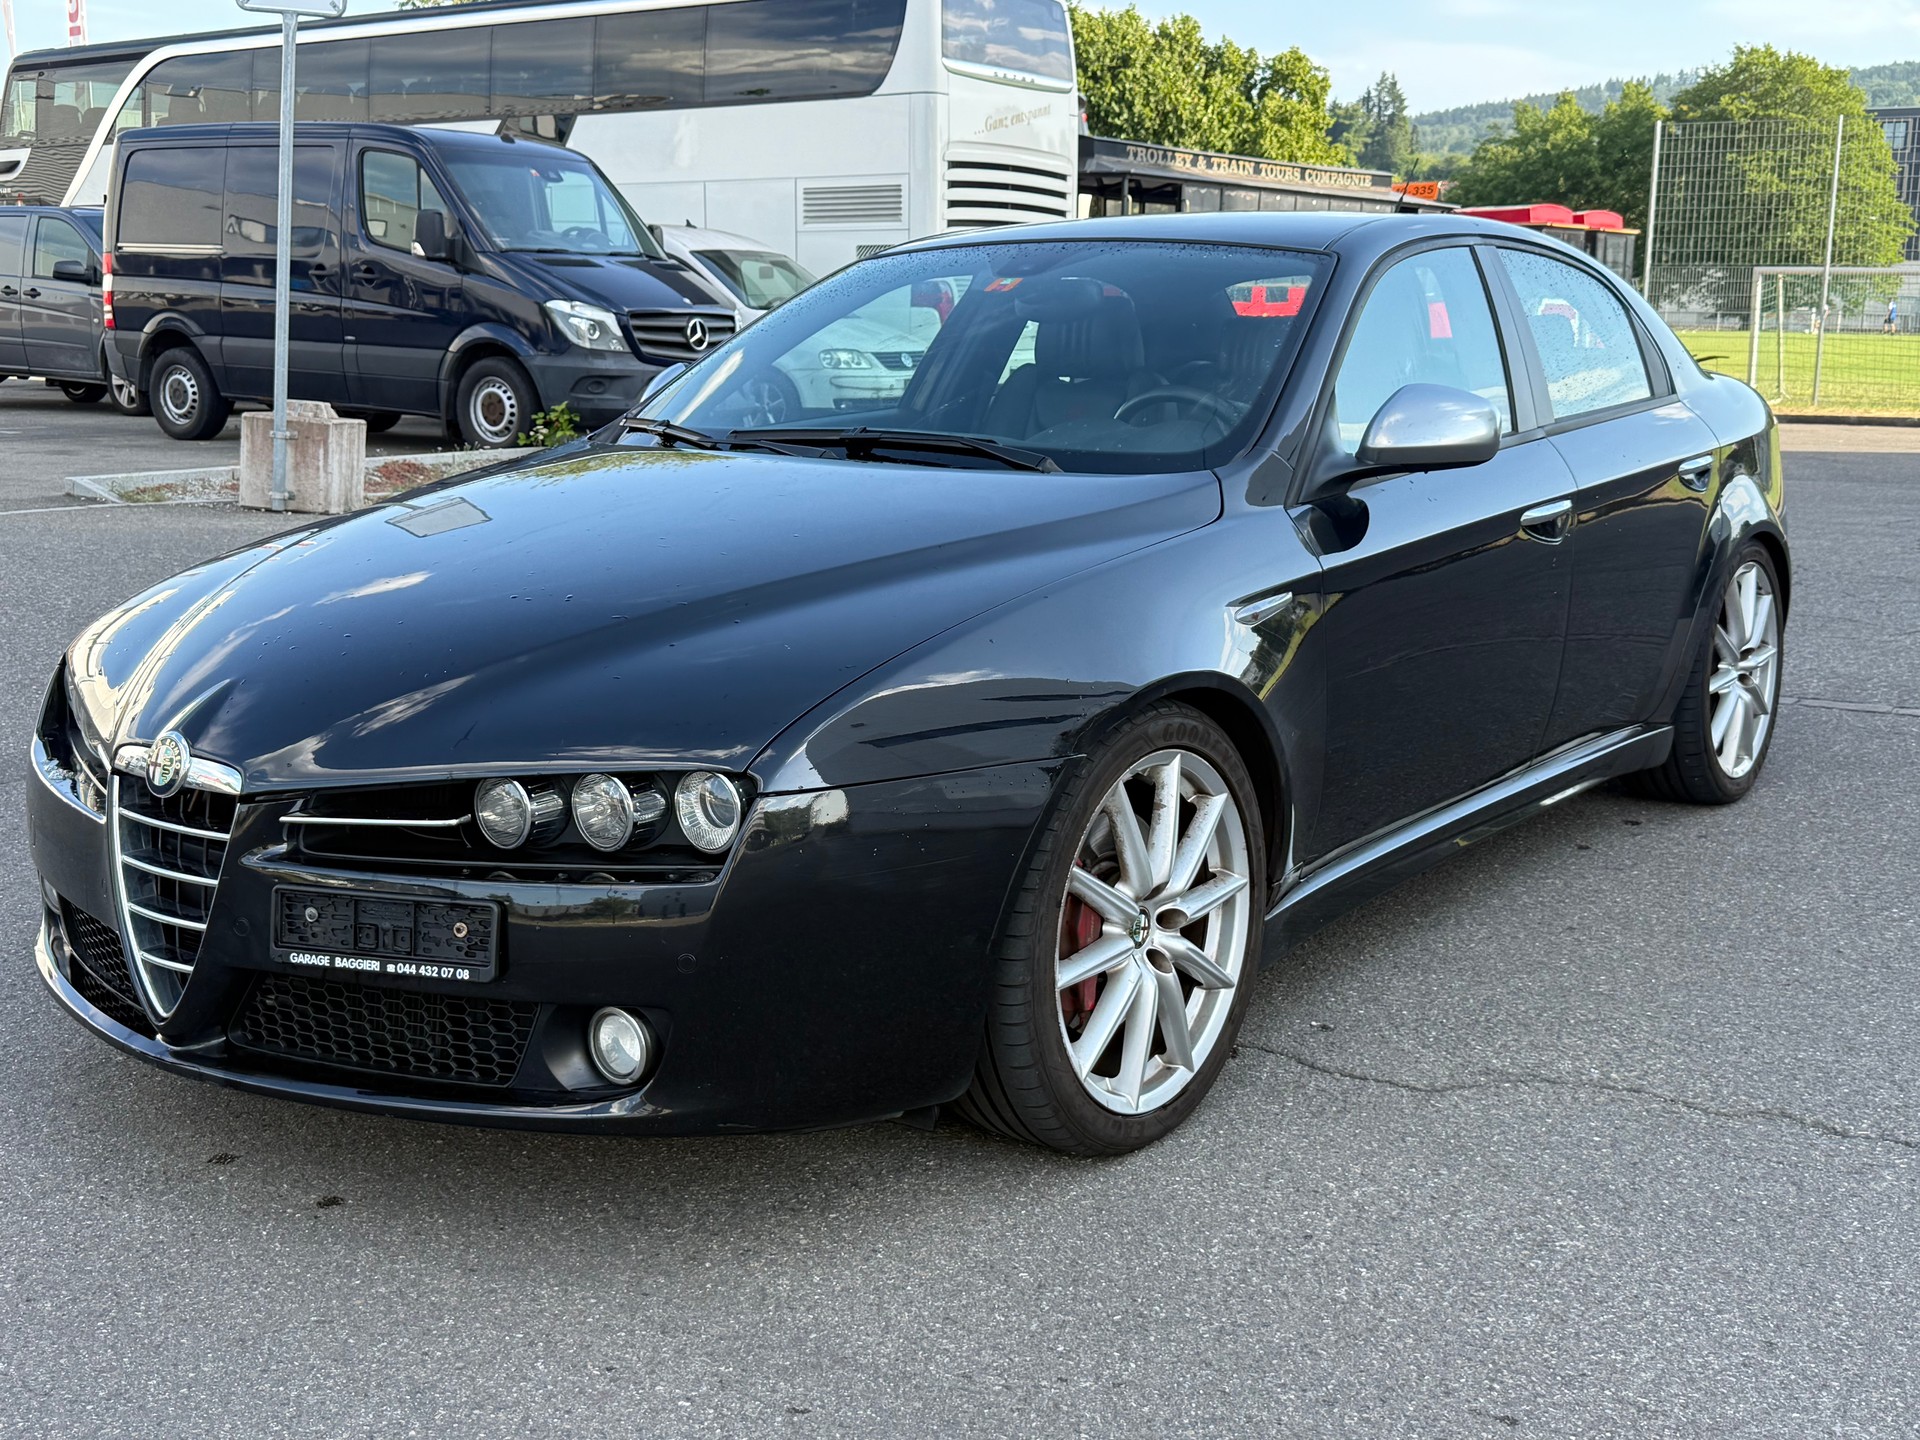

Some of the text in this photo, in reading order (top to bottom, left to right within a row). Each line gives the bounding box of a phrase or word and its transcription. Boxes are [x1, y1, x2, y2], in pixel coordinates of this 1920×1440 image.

[1126, 145, 1373, 188] TROLLEY & TRAIN TOURS COMPAGNIE
[289, 952, 470, 980] GARAGE BAGGIERI 044 432 07 08
